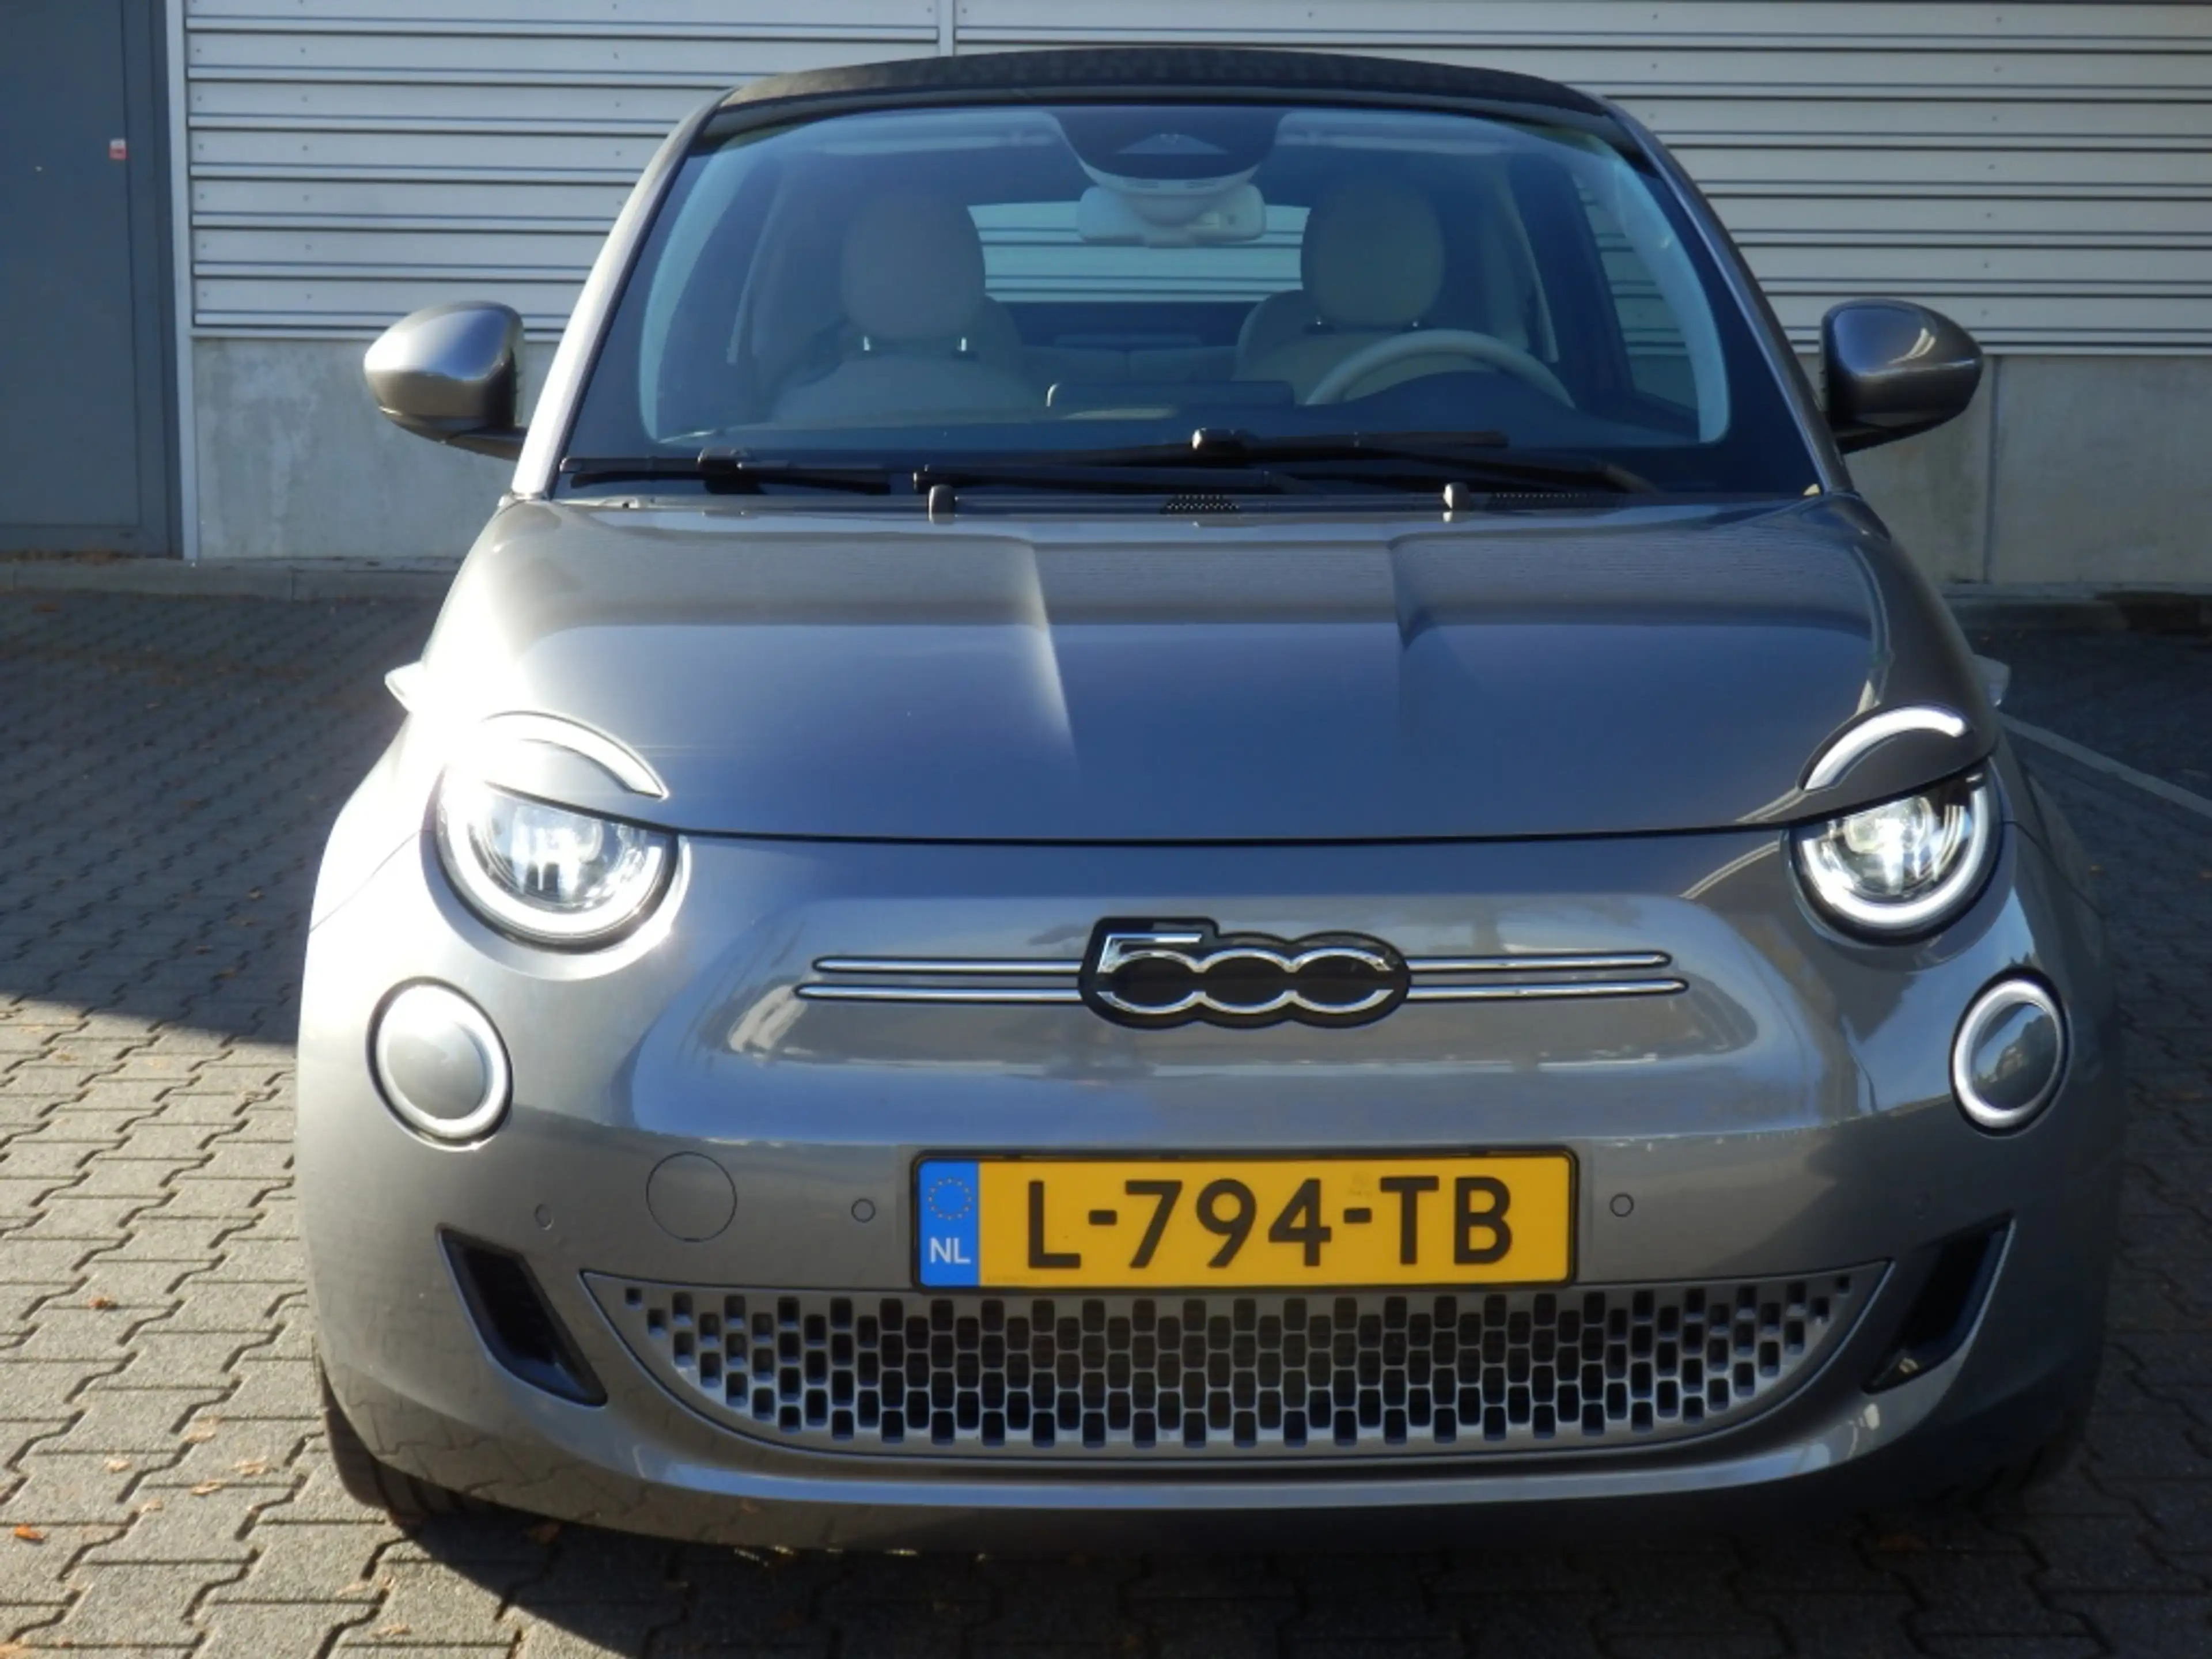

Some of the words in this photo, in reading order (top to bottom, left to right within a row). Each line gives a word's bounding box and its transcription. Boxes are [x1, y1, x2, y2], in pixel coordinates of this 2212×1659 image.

[1096, 932, 1395, 1015] 500
[930, 1237, 971, 1264] NL
[1027, 1175, 1513, 1269] L-794-TB
